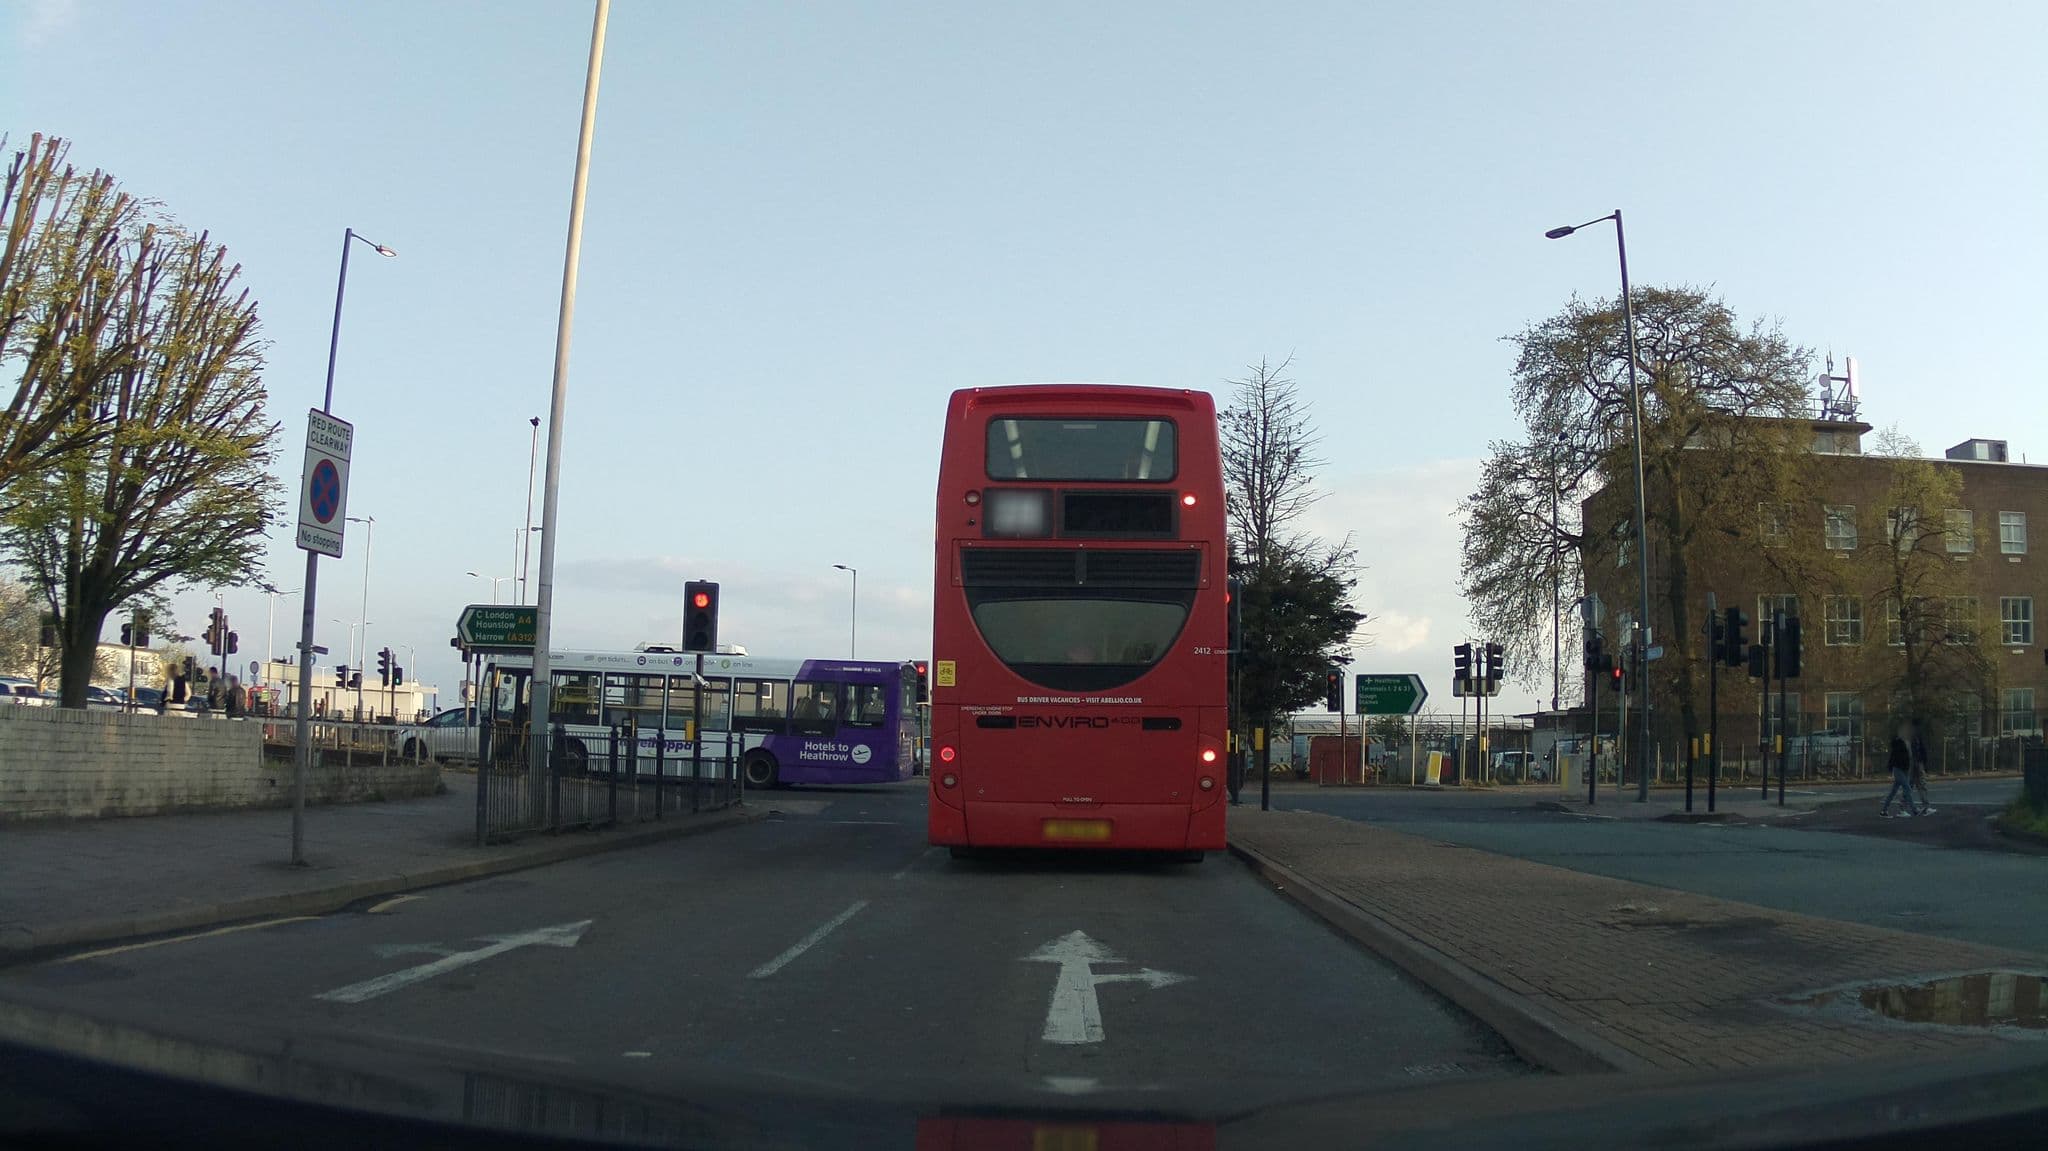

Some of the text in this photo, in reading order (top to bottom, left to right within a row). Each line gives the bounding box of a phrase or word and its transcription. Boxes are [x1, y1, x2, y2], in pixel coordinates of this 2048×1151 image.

[311, 416, 350, 441] RED ROUTE
[310, 430, 349, 454] CLEARWAY
[301, 529, 340, 552] No stopping
[476, 610, 531, 624] C London A4
[476, 621, 516, 629] Hounslow
[475, 633, 504, 641] Harrow
[1194, 647, 1211, 655] 2412
[1029, 696, 1050, 704] DRIVER
[1050, 696, 1080, 704] VACANCIES
[804, 741, 849, 752] Hotels to
[800, 750, 849, 761] Heathrow
